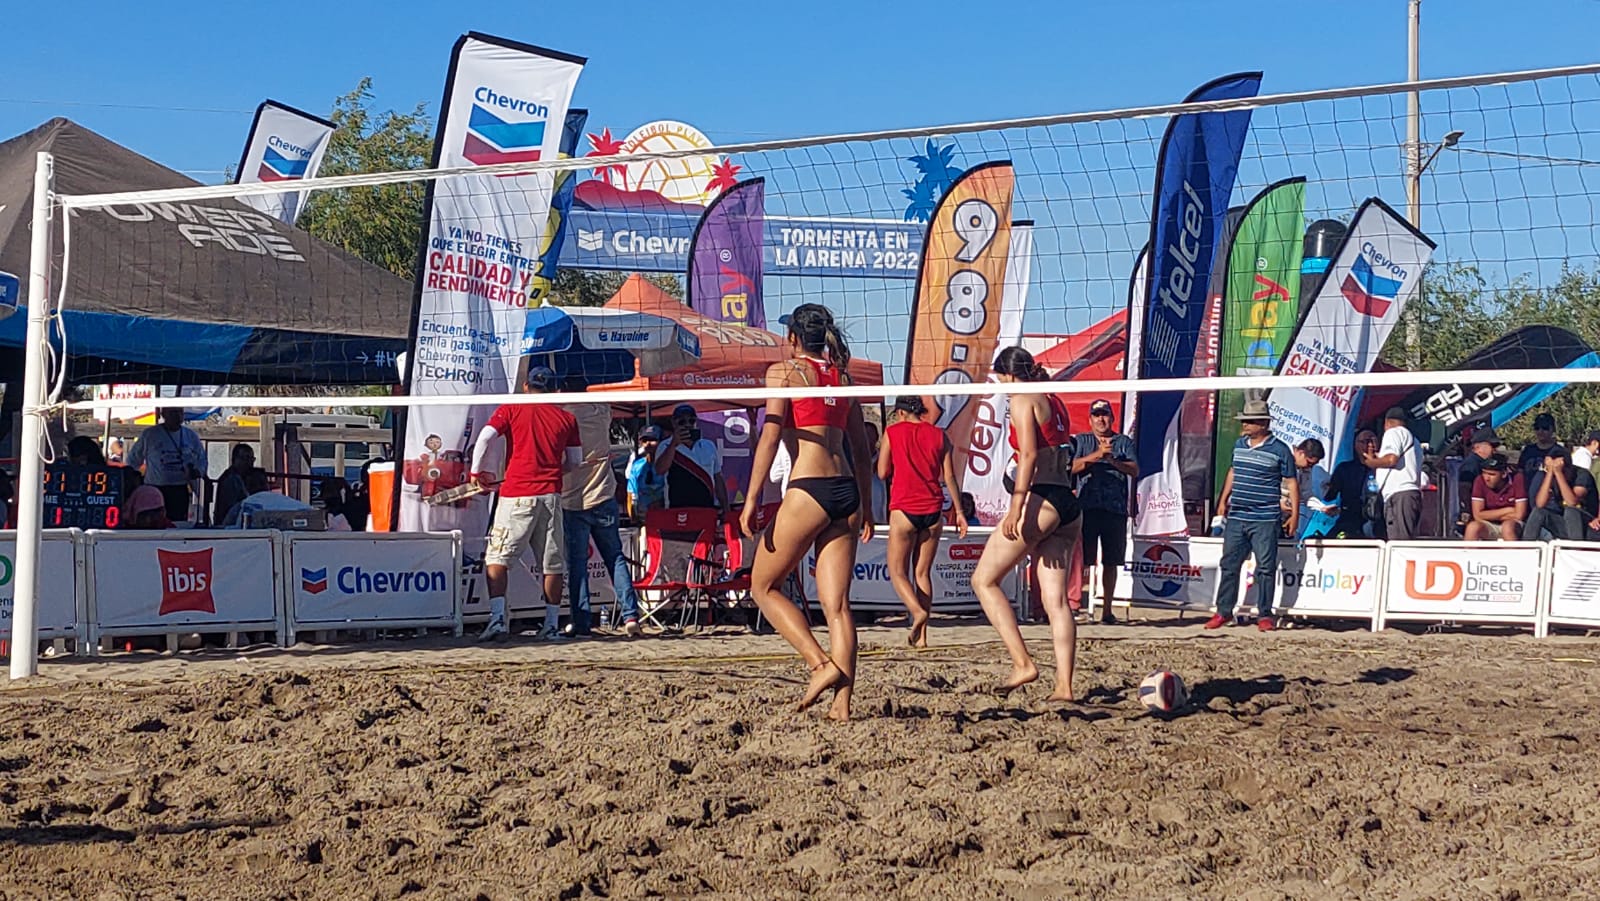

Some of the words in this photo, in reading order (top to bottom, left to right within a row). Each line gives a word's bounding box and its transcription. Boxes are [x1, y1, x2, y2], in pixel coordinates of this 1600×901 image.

[475, 86, 549, 118] Chevron
[267, 134, 311, 158] Chevron
[68, 204, 276, 234] OWER
[179, 223, 305, 261] ADE
[448, 226, 464, 240] YA
[466, 229, 482, 242] NO
[486, 233, 522, 254] TIENES
[612, 230, 693, 254] Chevr
[780, 228, 877, 249] TORMENTA
[885, 231, 909, 249] EN
[1157, 180, 1205, 319] telcel
[431, 236, 454, 252] QUE
[456, 241, 497, 260] ELEGIR
[499, 250, 535, 271] ENTRE
[775, 247, 799, 266] LA
[803, 250, 867, 268] ARENA
[873, 252, 918, 270] 2022
[1361, 241, 1408, 280] Chevron
[429, 251, 511, 286] CALIDAD
[518, 271, 532, 290] Y
[427, 273, 527, 307] RENDIMIENTO
[420, 335, 433, 346] en
[437, 336, 447, 348] la
[418, 347, 465, 365] Chevron
[417, 361, 484, 385] TECHRON
[86, 471, 108, 495] 19
[45, 495, 58, 505] ME
[86, 496, 116, 505] GUEST
[105, 506, 120, 528] 0
[167, 567, 207, 593] ibis
[337, 566, 447, 593] Chevron
[1123, 560, 1202, 578] DIGIMARK
[1467, 560, 1508, 576] Línea
[1466, 577, 1523, 593] Directa
